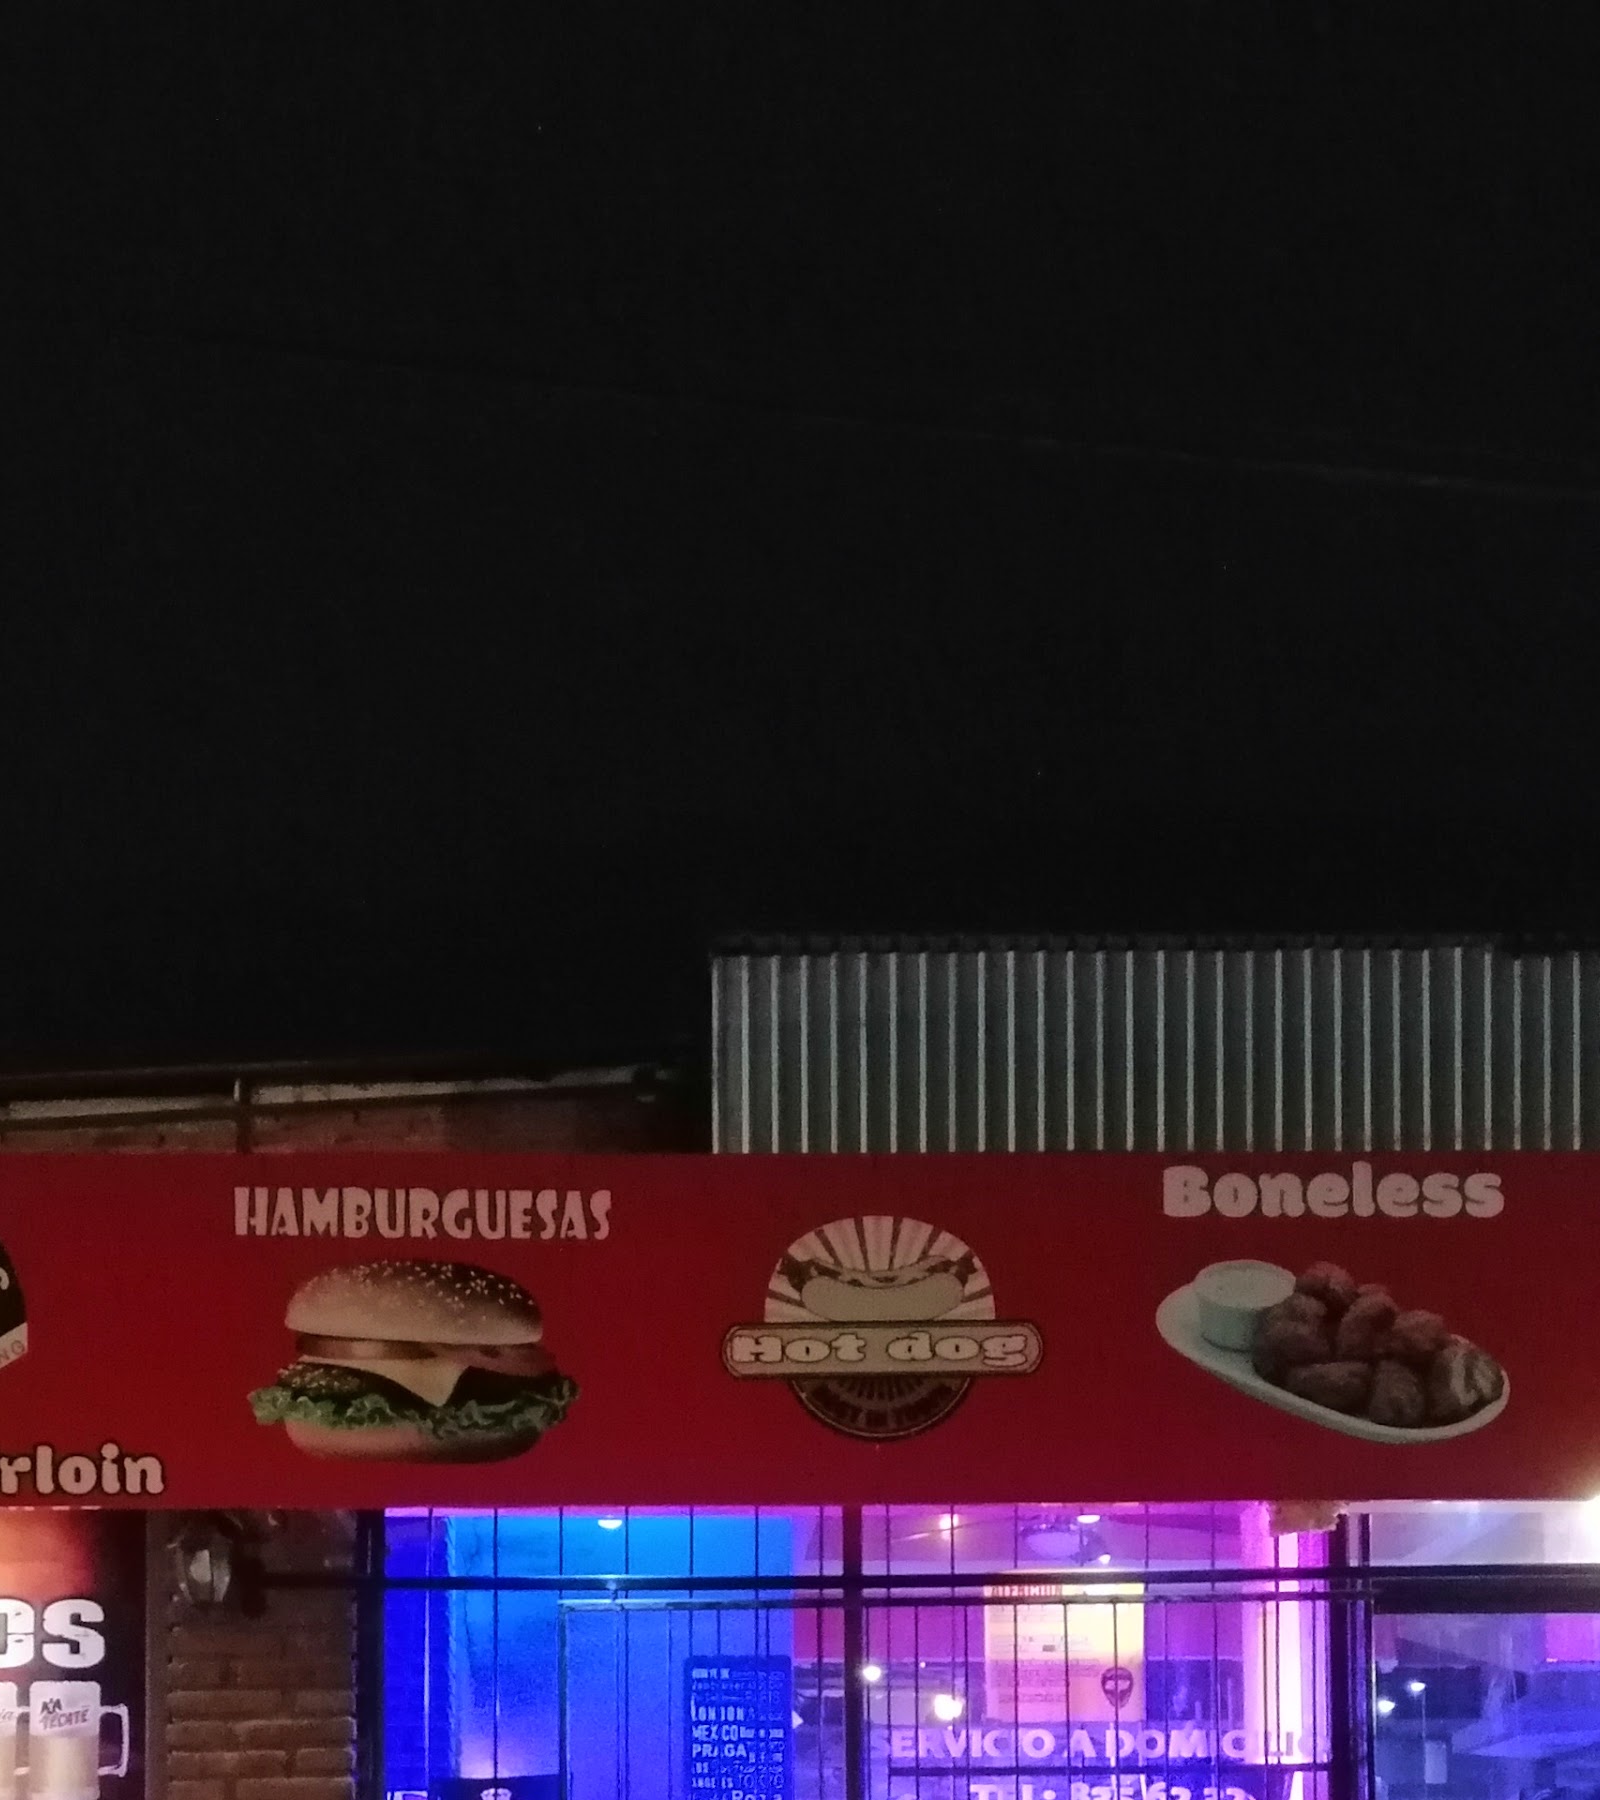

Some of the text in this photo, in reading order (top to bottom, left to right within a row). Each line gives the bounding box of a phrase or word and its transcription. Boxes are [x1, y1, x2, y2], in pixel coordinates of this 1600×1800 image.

[1162, 1161, 1505, 1218] Boneless
[233, 1186, 613, 1241] HAMBURGUESAS
[730, 1331, 1028, 1368] Hot dog
[1062, 1728, 1098, 1759] A
